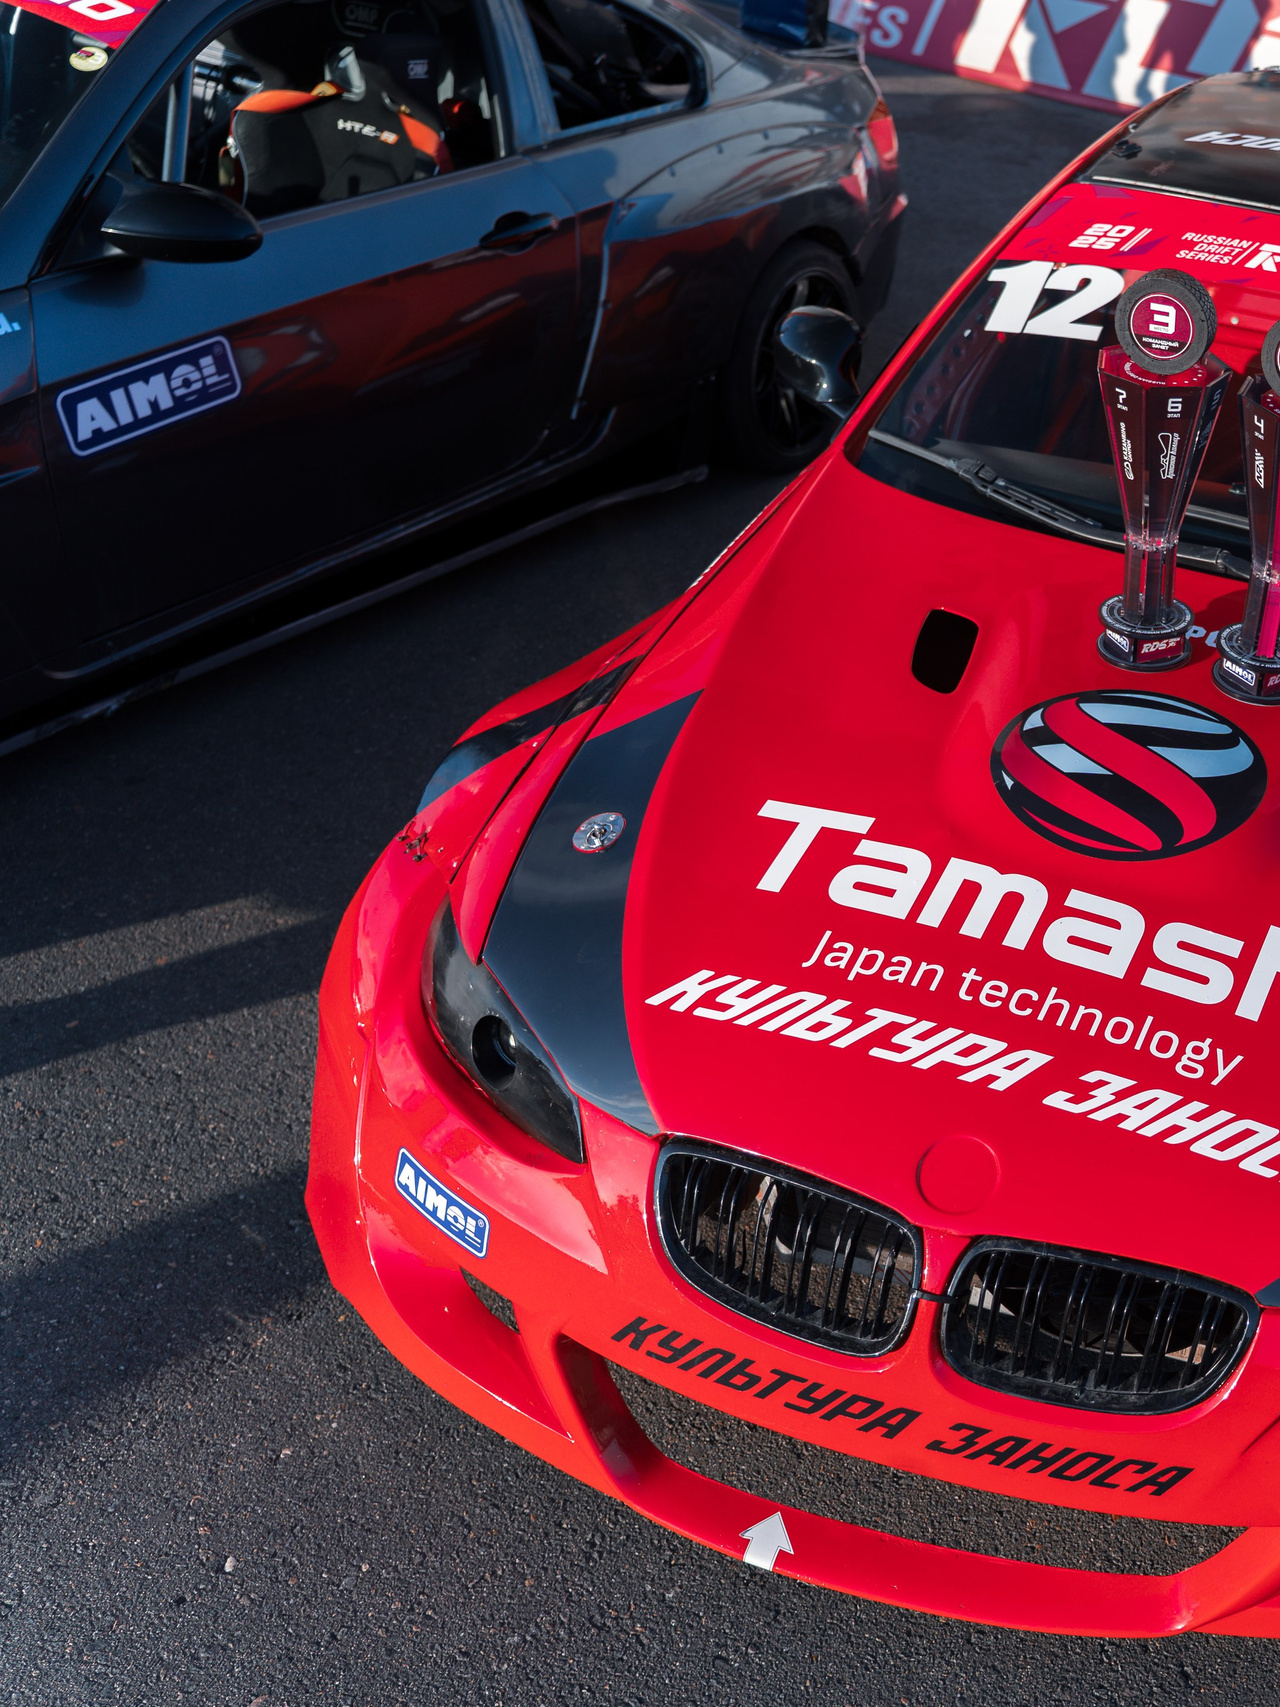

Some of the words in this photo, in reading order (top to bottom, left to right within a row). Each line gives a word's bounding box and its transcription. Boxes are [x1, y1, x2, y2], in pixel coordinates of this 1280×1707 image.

[1083, 223, 1136, 238] 20
[1068, 235, 1122, 250] 25
[1181, 231, 1253, 249] RUSSIAN
[1193, 242, 1243, 256] DRIFT
[1175, 249, 1233, 265] SERIES
[984, 259, 1125, 342] 12
[1148, 302, 1177, 335] 3
[1142, 336, 1180, 348] КОМАНДНЫЙ
[76, 353, 233, 444] AIMOL
[1115, 387, 1127, 404] 7
[1167, 397, 1183, 413] 6
[1140, 639, 1169, 654] RDS
[1225, 660, 1254, 685] AIMOL
[801, 929, 945, 995] Japan
[960, 966, 1245, 1087] technology
[643, 968, 1056, 1092] КУЛЬТУРА
[398, 1161, 482, 1248] AIMOL
[610, 1314, 924, 1441] КУЛЬТУРА
[923, 1420, 1196, 1499] ЗАНОСА
